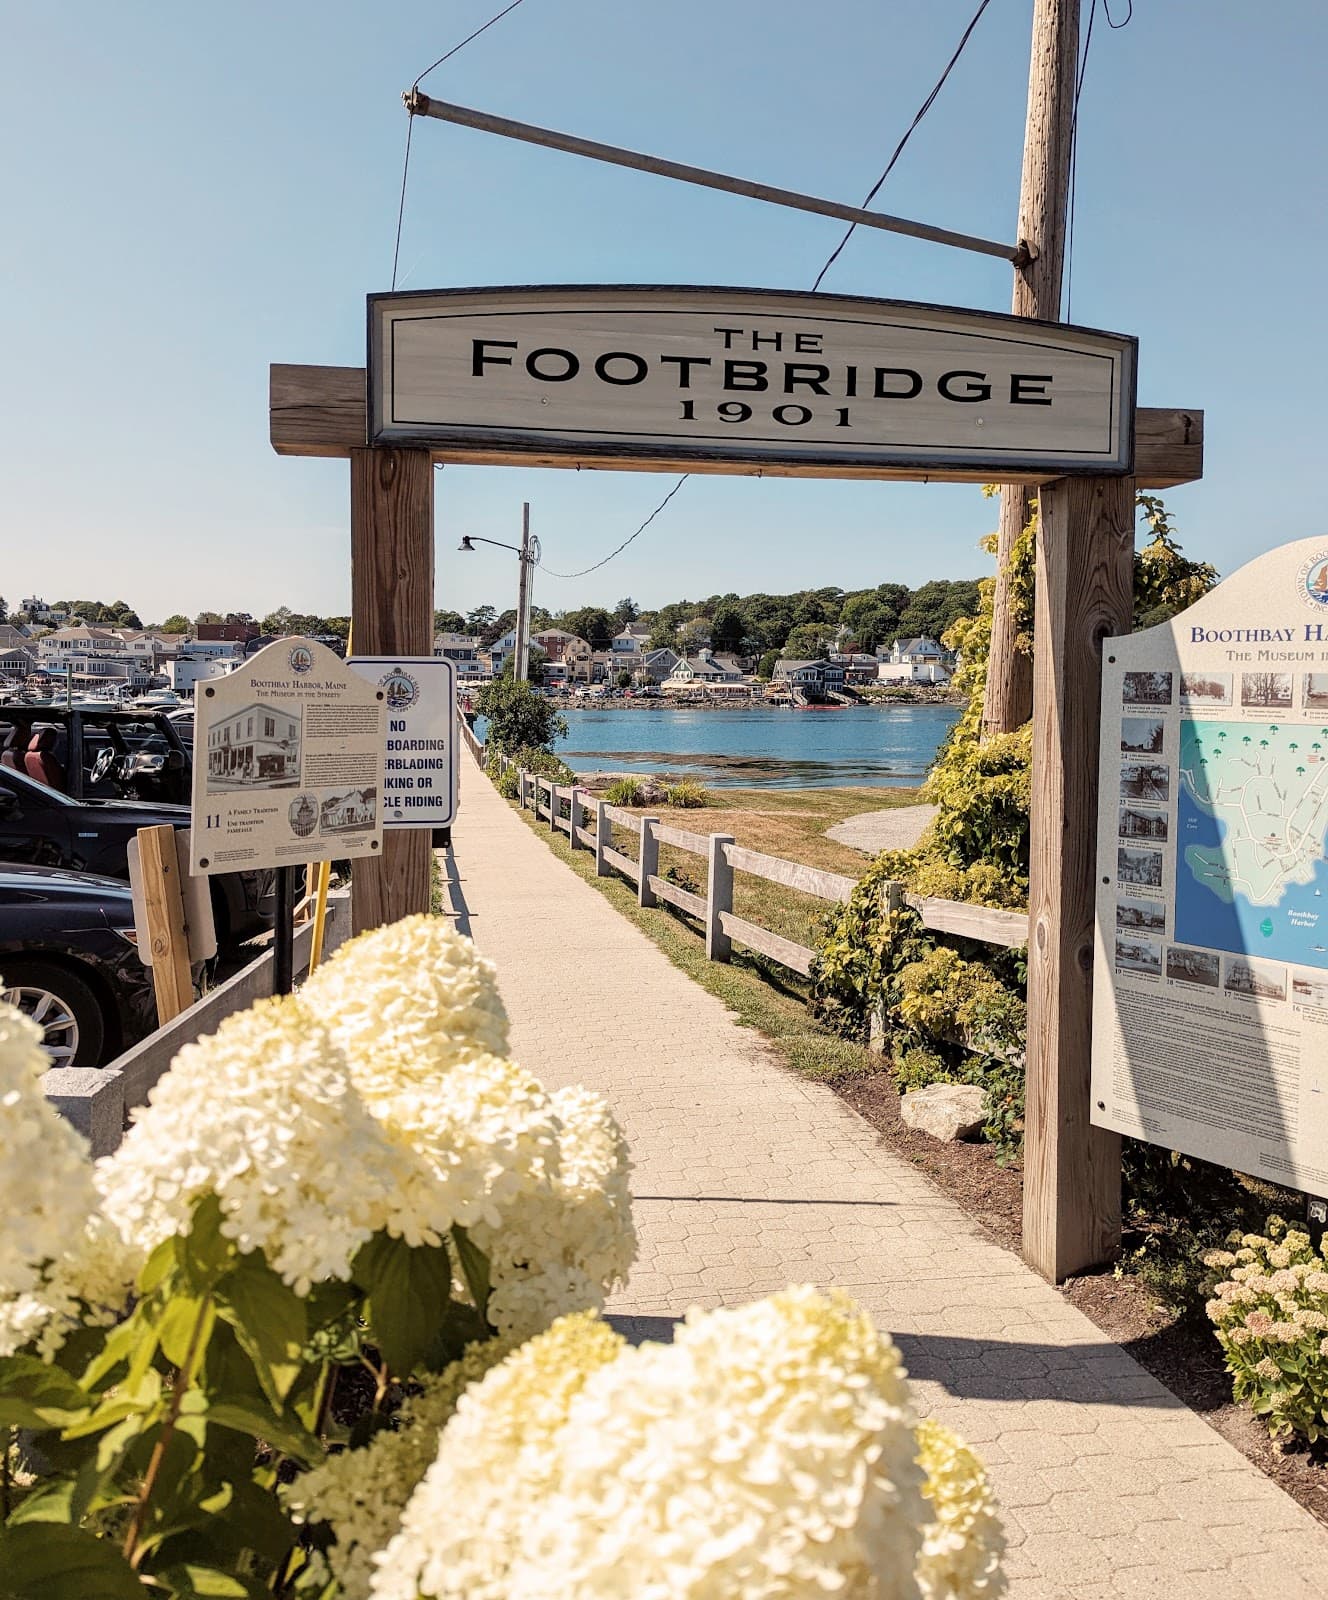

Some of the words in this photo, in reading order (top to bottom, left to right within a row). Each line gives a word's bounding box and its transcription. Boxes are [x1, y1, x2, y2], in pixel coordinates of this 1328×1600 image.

[714, 327, 824, 354] THE
[471, 338, 1053, 406] FOOTBRIDGE
[678, 399, 853, 427] 1901
[1297, 577, 1311, 602] TOWN
[1190, 626, 1296, 643] BOOTHBAY
[1304, 623, 1328, 642] H
[1225, 650, 1252, 661] THE
[1257, 650, 1314, 661] MUSEUM
[250, 679, 290, 689] BOOTHBAY
[325, 681, 347, 690] MAINE
[270, 690, 295, 698] MUSEUM
[390, 720, 406, 732] NO
[387, 739, 445, 751] BOARDING
[417, 777, 433, 788] OR
[405, 796, 443, 807] RIDING
[206, 814, 220, 829] 11
